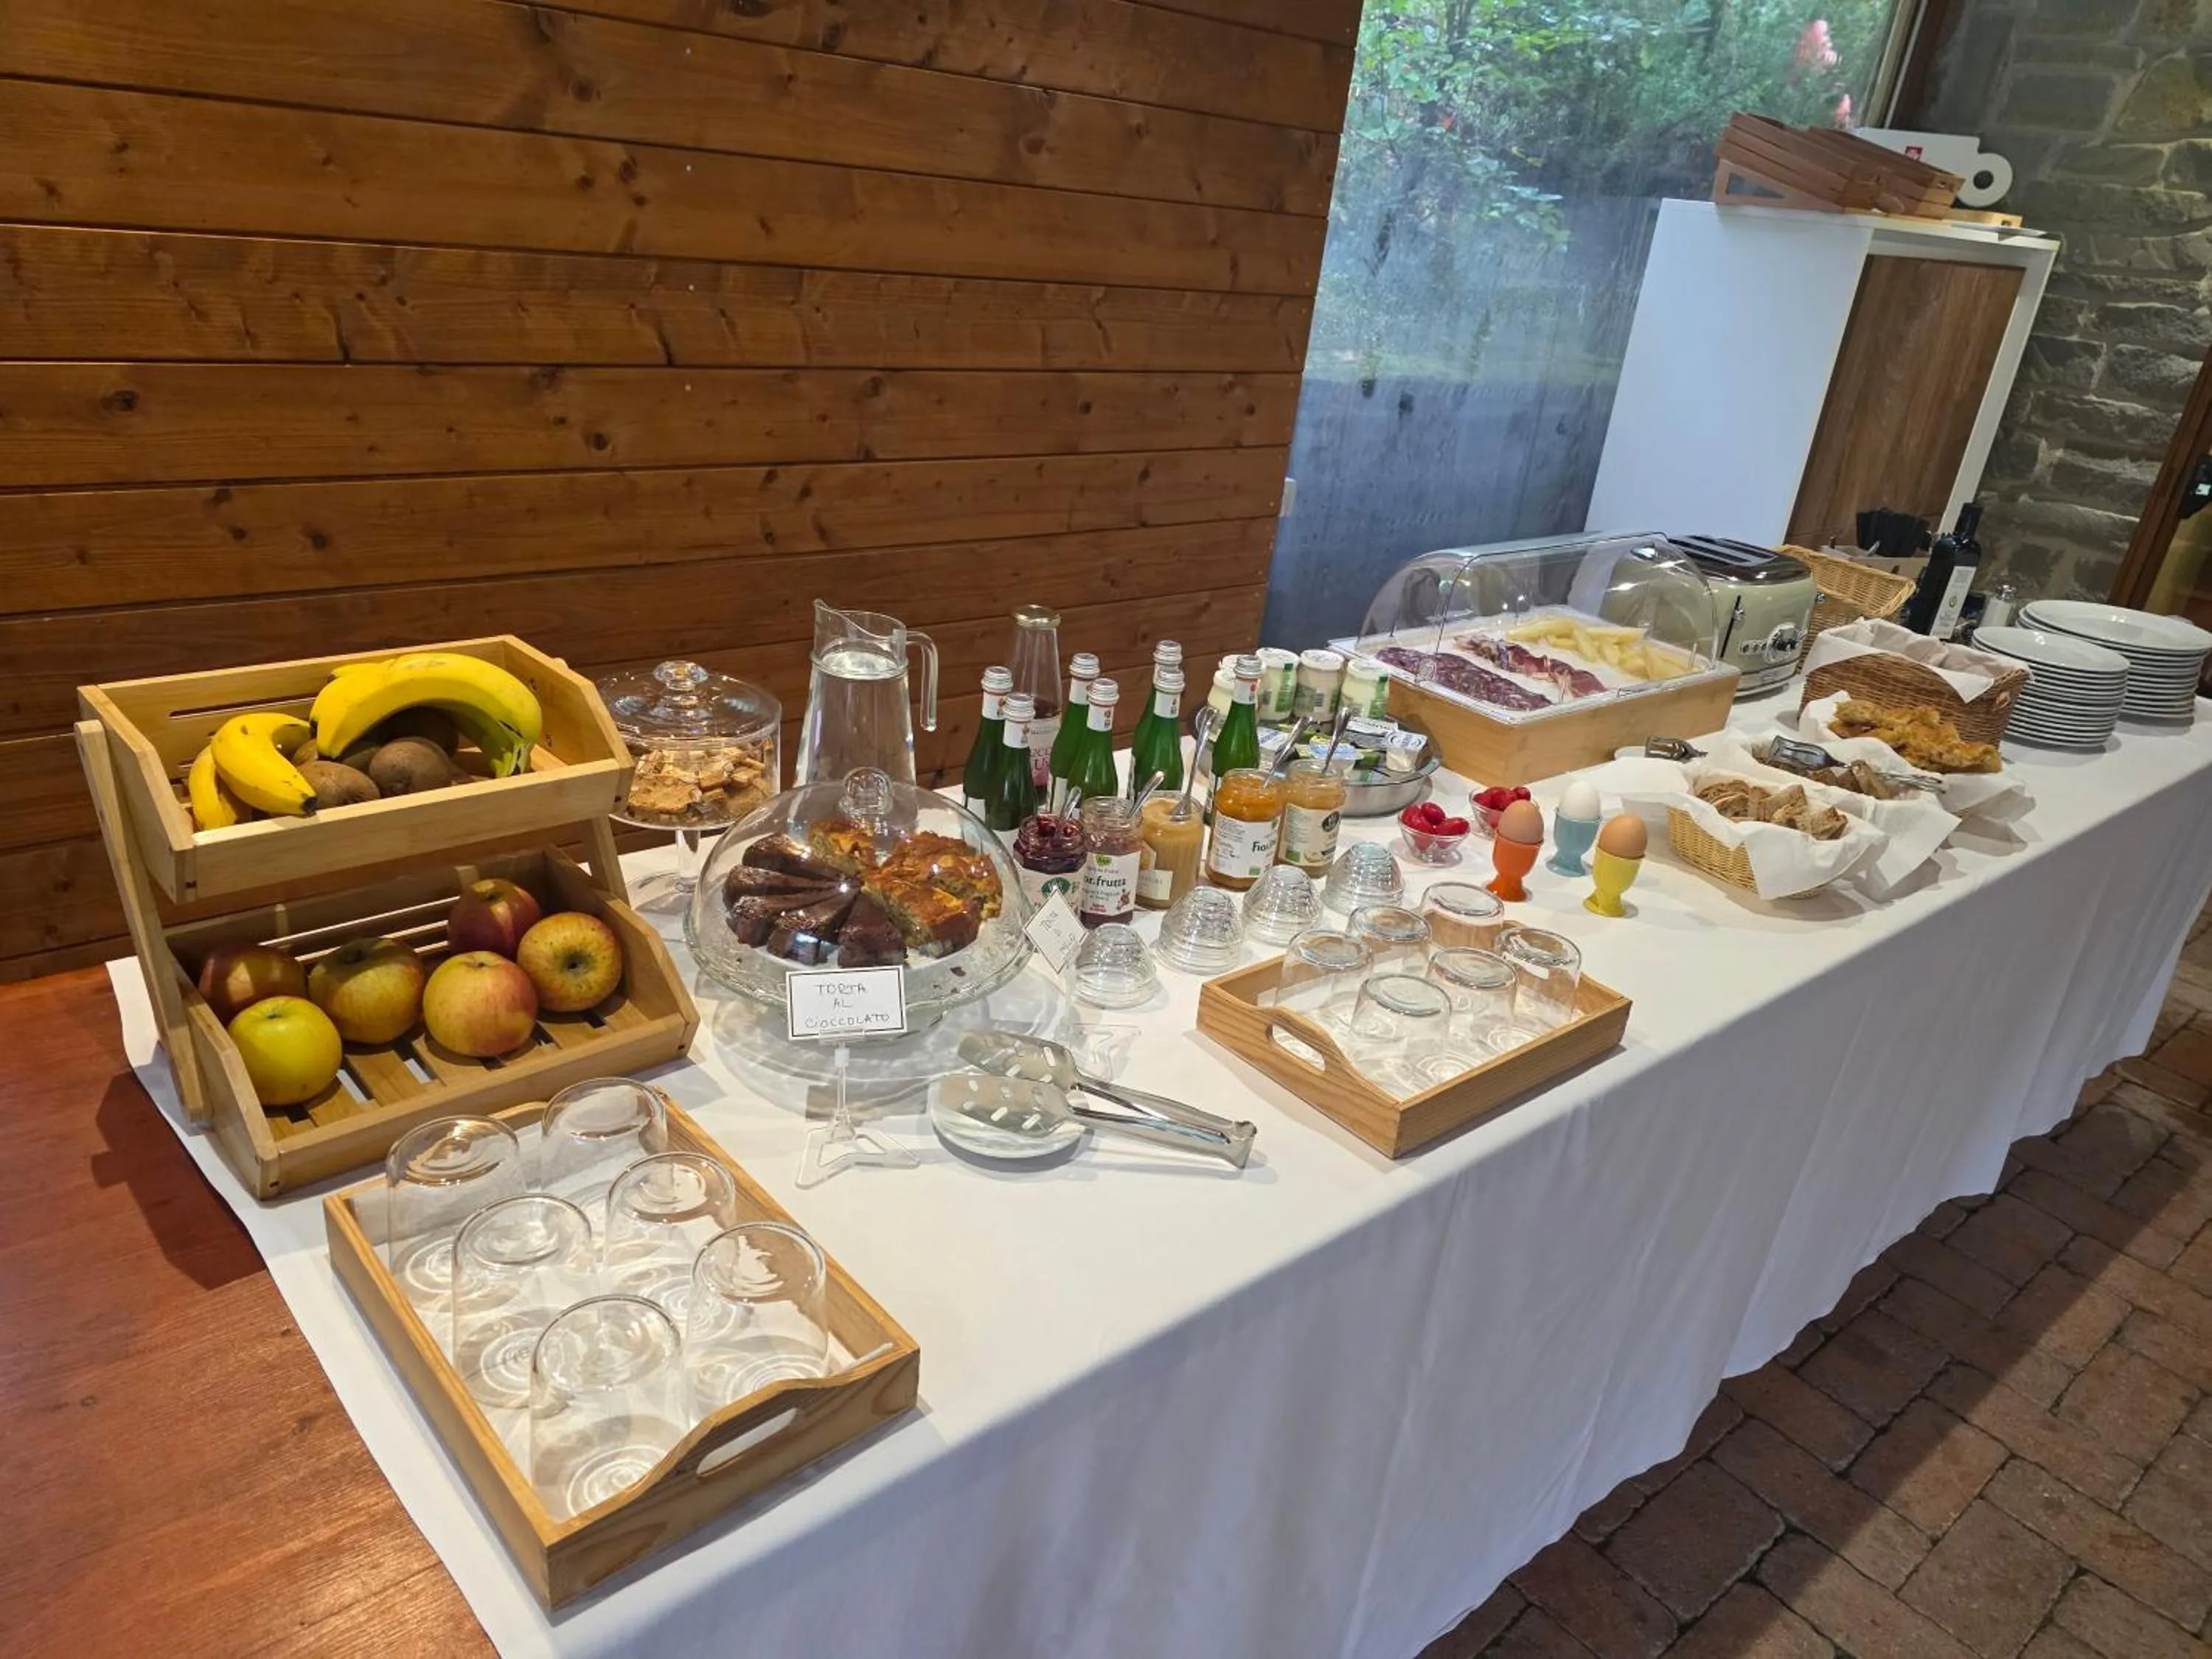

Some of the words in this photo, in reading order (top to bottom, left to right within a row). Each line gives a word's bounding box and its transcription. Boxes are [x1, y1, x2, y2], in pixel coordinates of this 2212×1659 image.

[814, 983, 867, 995] TORTA
[833, 998, 852, 1009] AL
[804, 1013, 891, 1029] CIOCCOLATO
